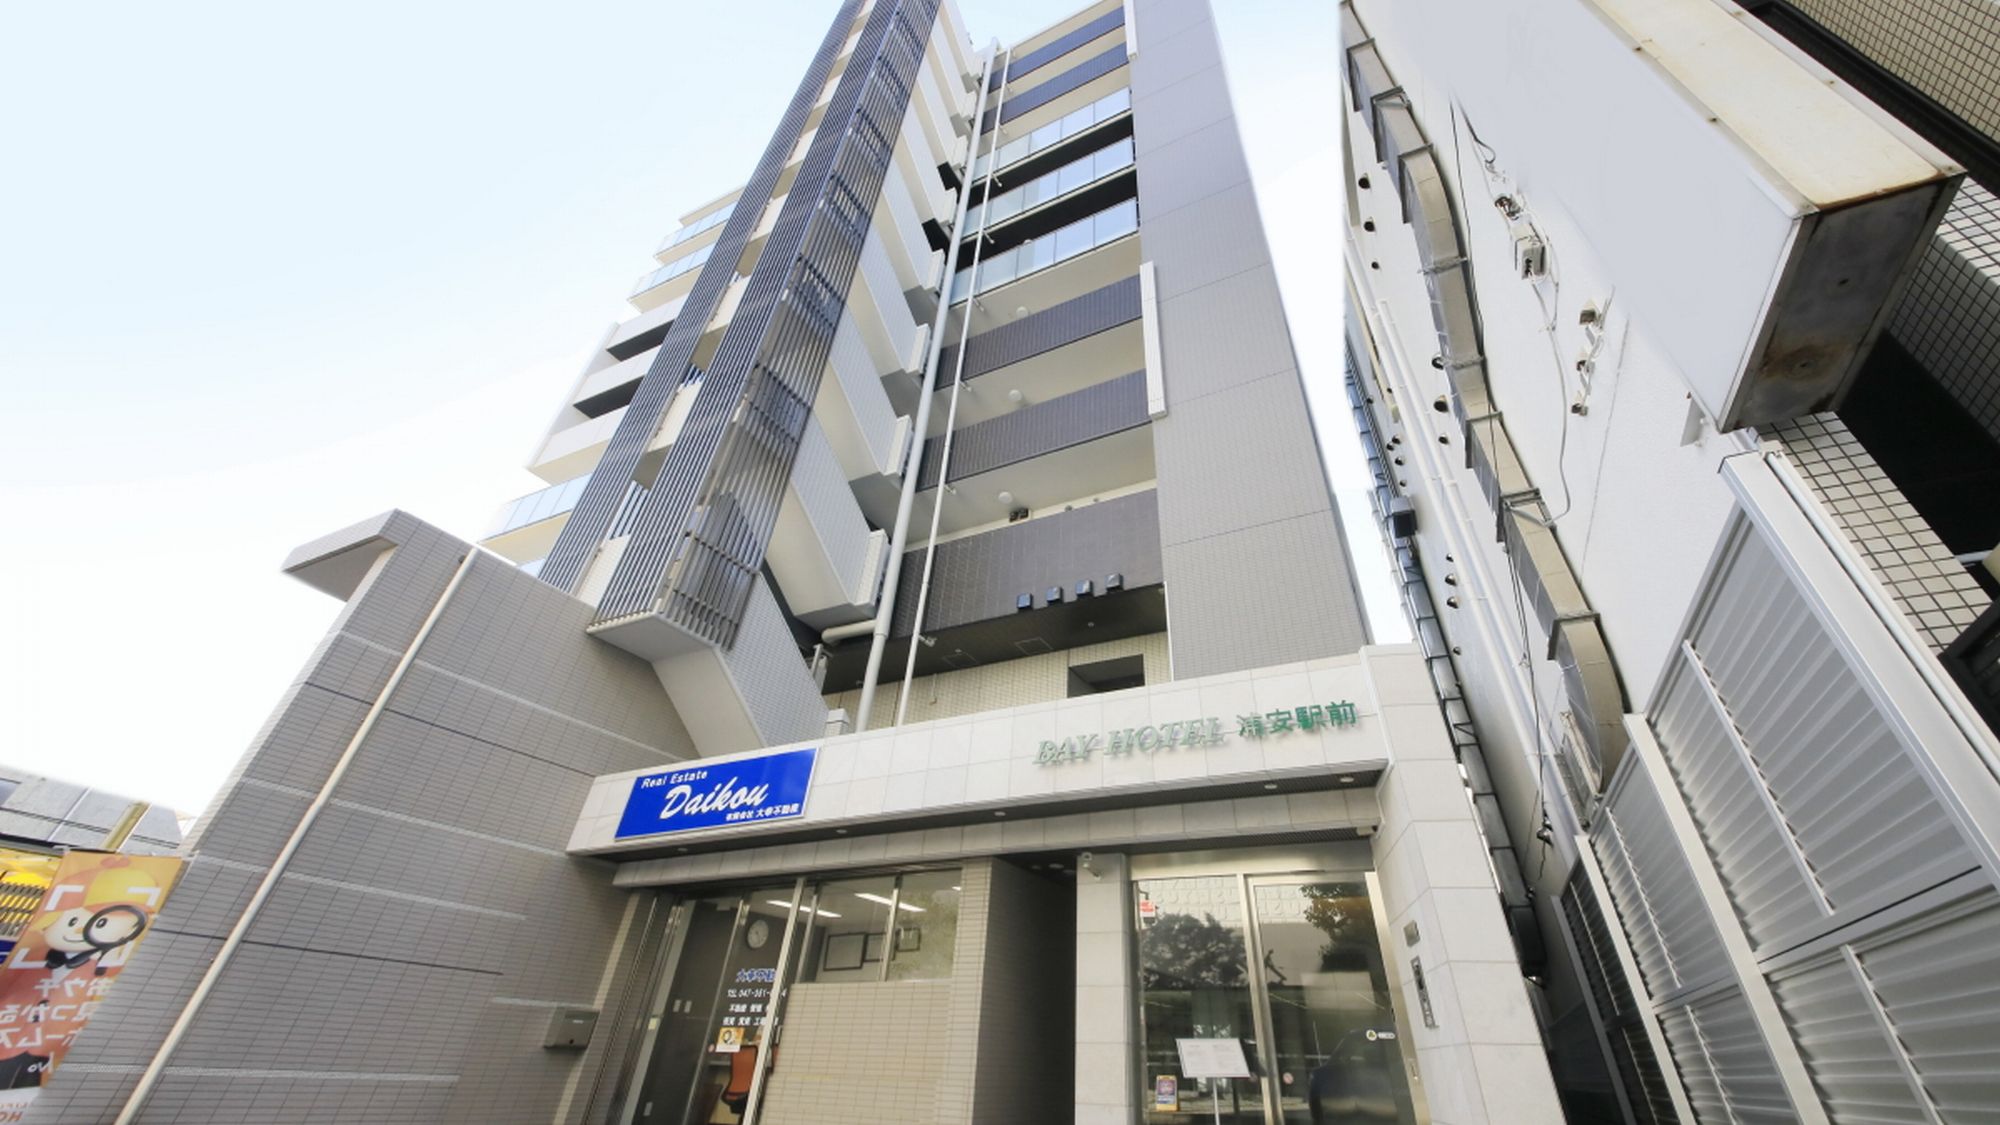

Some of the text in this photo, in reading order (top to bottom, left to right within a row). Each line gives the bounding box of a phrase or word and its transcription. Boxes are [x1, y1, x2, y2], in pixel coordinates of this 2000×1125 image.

[1034, 700, 1357, 764] BAY HOTEL 浦安駅前
[641, 770, 708, 789] Real Estate
[659, 776, 769, 820] Daikou
